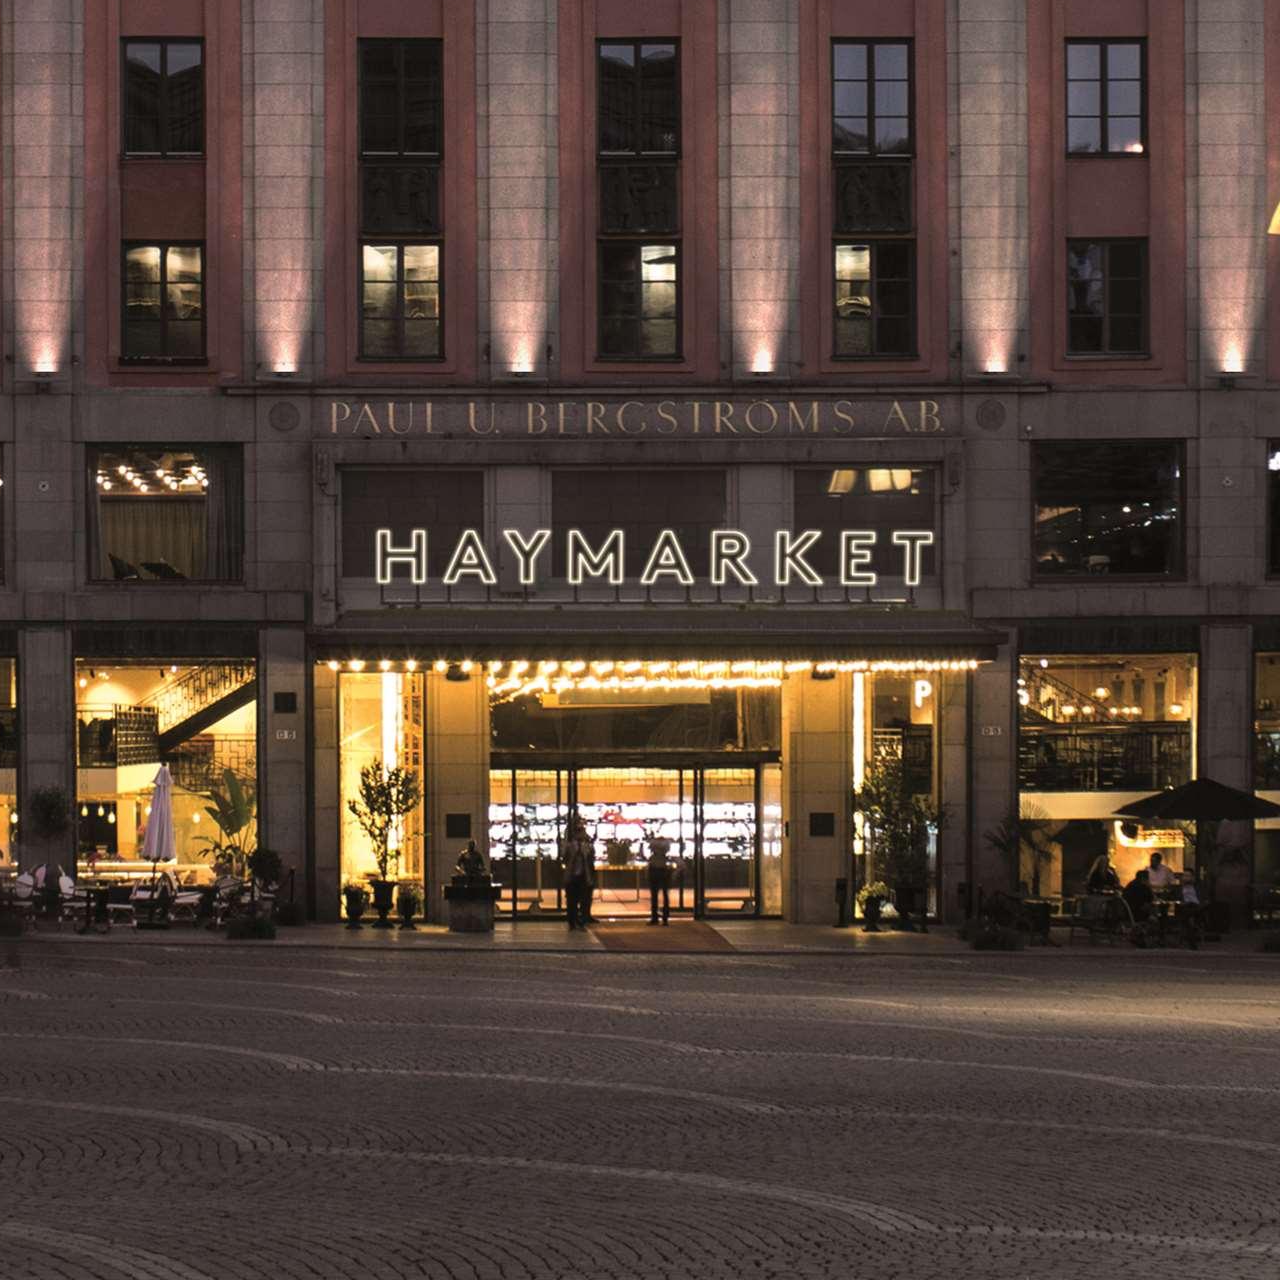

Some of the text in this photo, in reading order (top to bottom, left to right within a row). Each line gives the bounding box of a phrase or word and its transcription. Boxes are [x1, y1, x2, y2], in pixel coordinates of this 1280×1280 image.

[331, 399, 945, 434] PAUL U. BERGSTRÖMS A.B.
[374, 528, 935, 587] HAYMARKET
